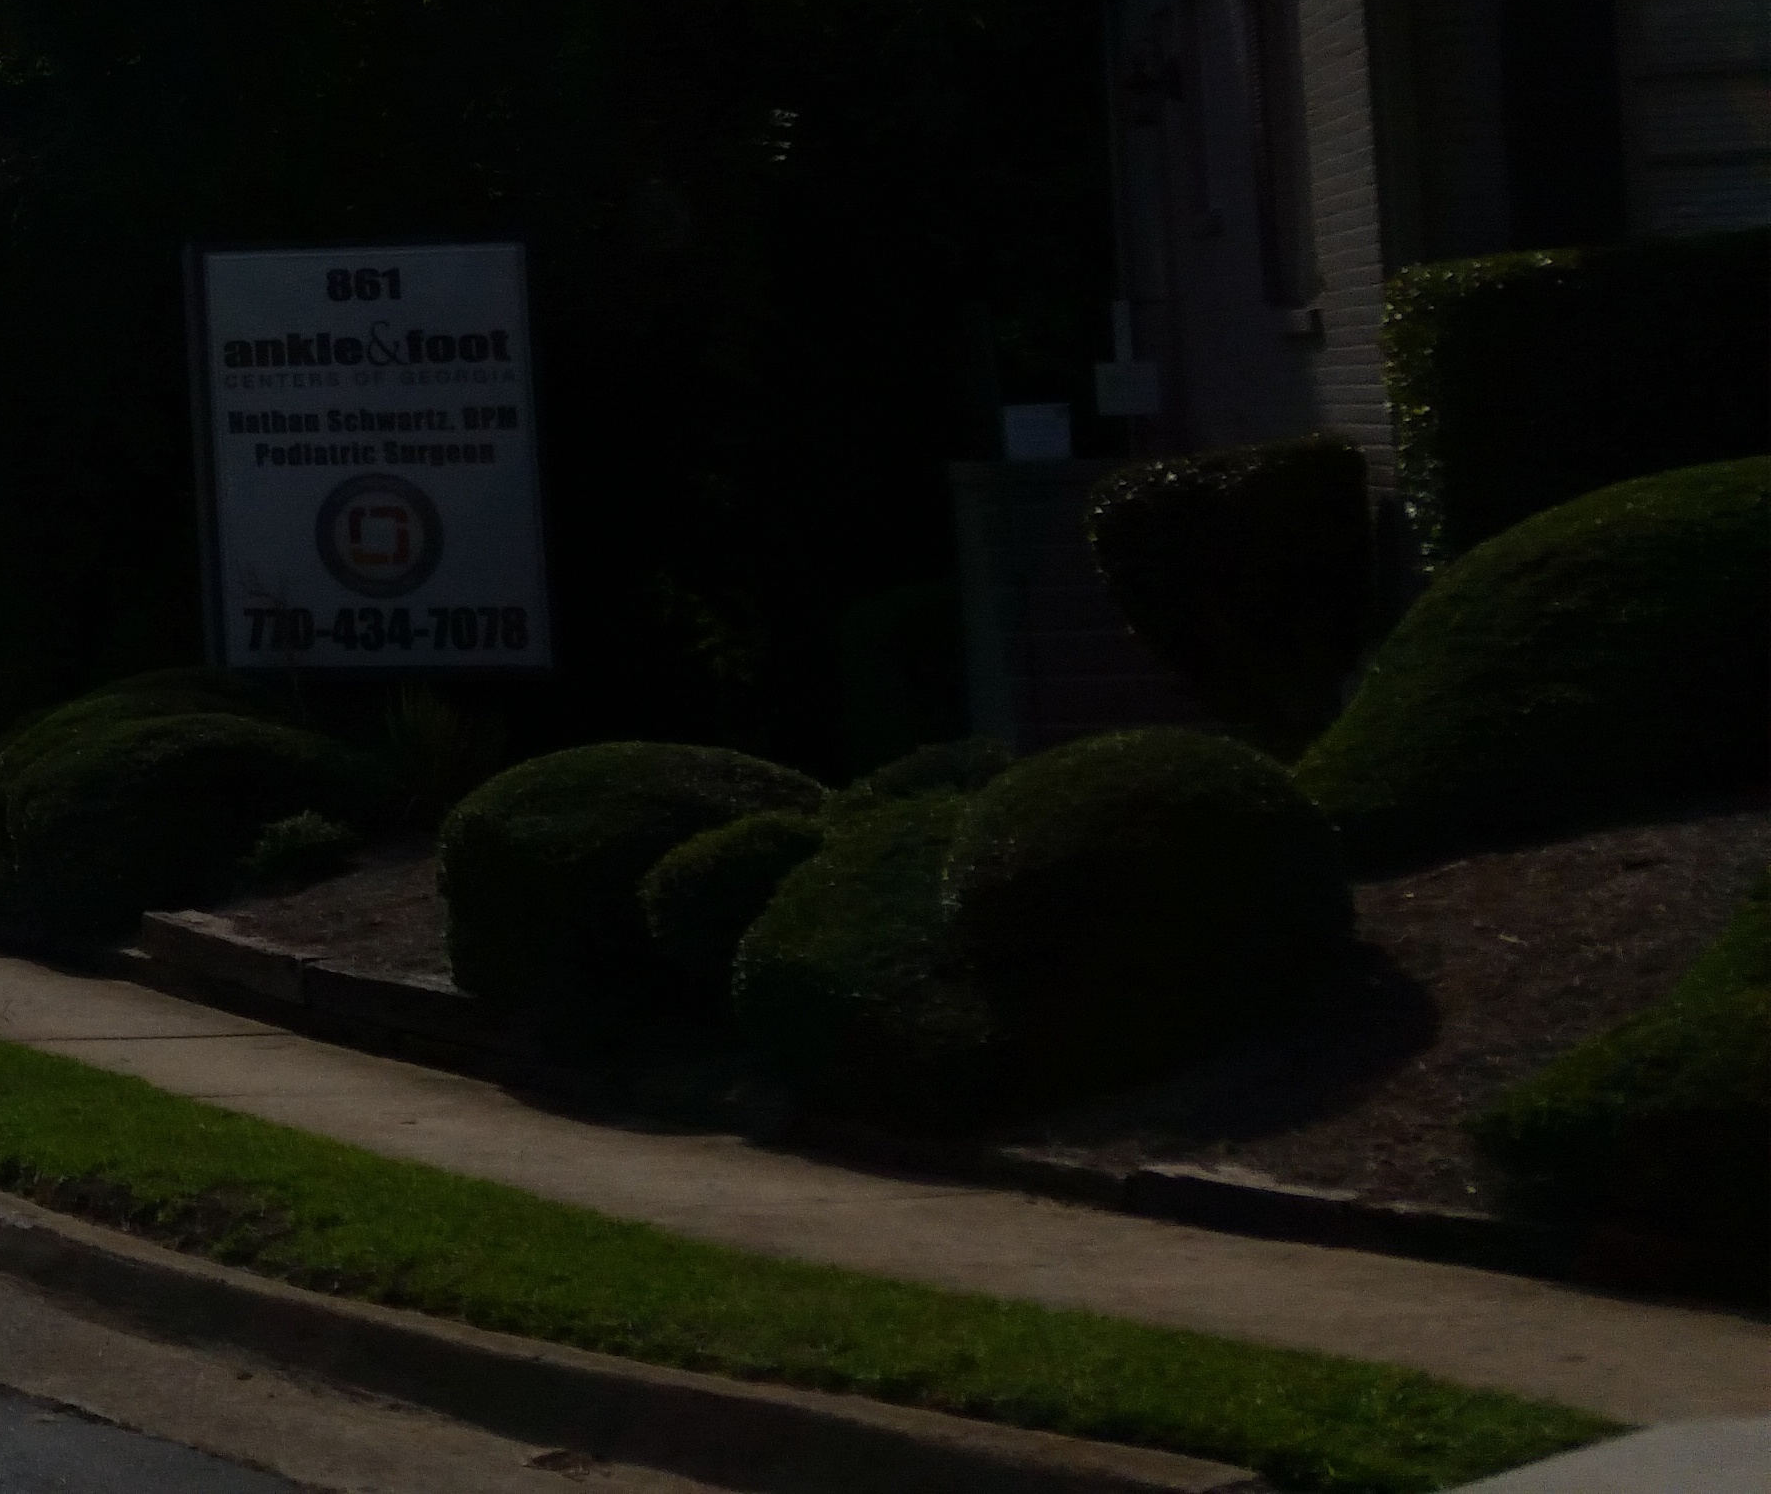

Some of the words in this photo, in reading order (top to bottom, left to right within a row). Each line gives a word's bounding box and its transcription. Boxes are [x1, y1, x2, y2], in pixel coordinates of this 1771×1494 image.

[326, 267, 402, 302] 861
[224, 372, 340, 389] CENTERS
[359, 372, 384, 387] OF
[401, 369, 517, 387] GEORGIA
[228, 410, 320, 434] Nathan
[327, 408, 456, 433] Schwartz,
[462, 406, 519, 431] DPM
[384, 440, 496, 467] Surgeon
[243, 607, 529, 652] 770-434-7078
